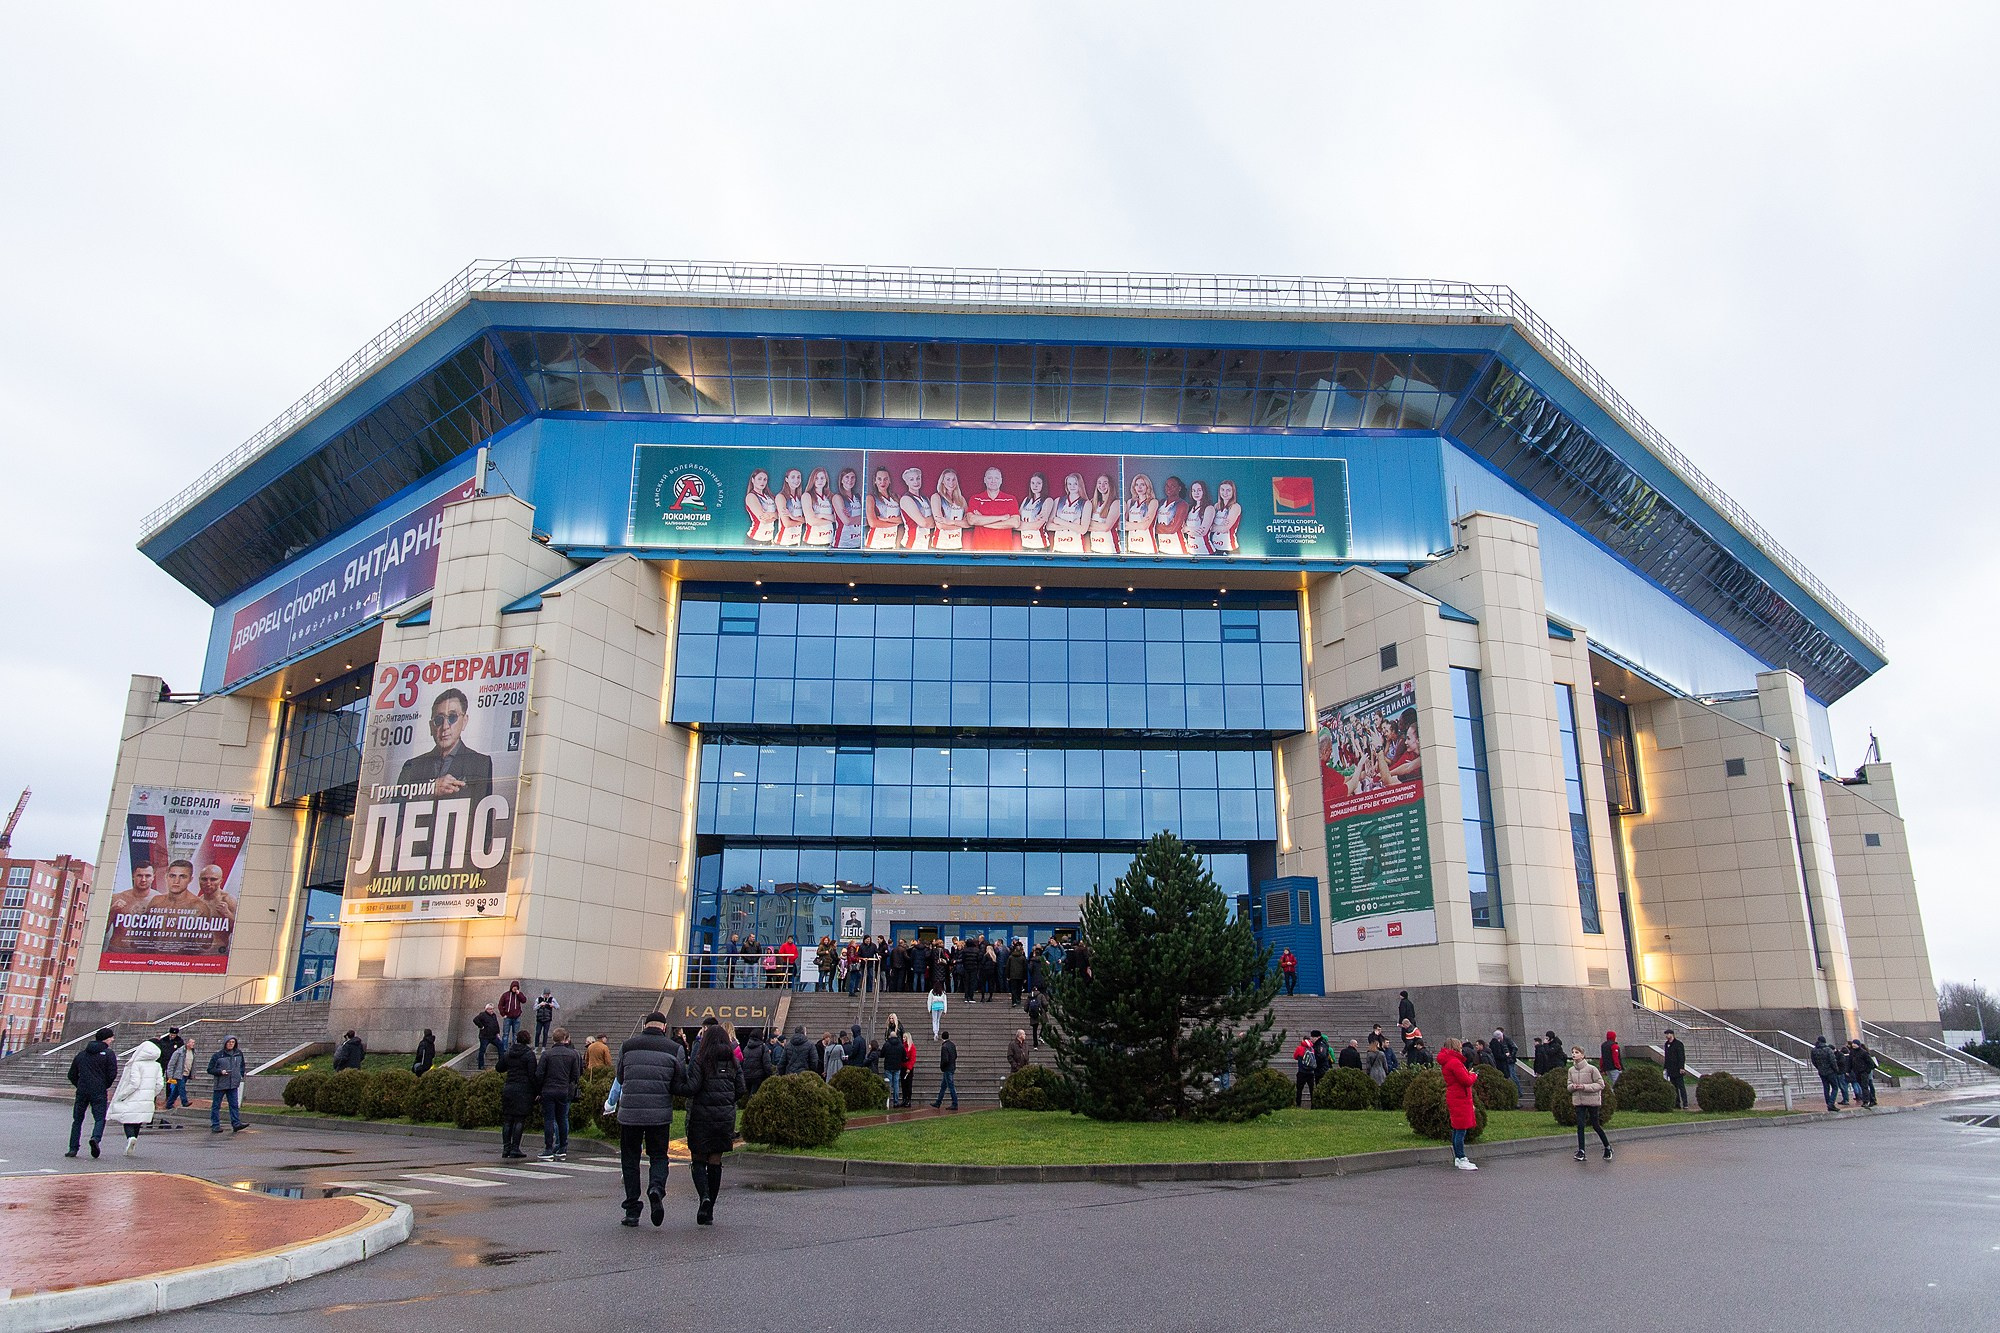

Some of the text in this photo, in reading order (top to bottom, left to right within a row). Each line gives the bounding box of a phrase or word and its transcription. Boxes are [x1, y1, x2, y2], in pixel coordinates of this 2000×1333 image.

[1266, 524, 1325, 533] ЯНТАРНЫЙ
[232, 608, 282, 654] ДВОРЕЦ
[284, 578, 336, 622] СПОРТА
[375, 652, 529, 710] 23 ФЕВРАЛЯ
[479, 681, 526, 694] ИНФОРМАЦИЯ
[477, 692, 525, 708] 507-208
[371, 725, 413, 748] 19:00
[370, 779, 436, 801] Григорий
[163, 795, 168, 805] 1
[171, 795, 220, 809] ФЕВРАЛЯ
[1330, 806, 1357, 818] ДОМАШНИЕ
[1358, 802, 1372, 810] ИГРЫ
[212, 835, 240, 843] ГОРОХОВ
[354, 794, 510, 875] ЛЕПС
[366, 873, 487, 895] «ИДИ И СМОТРИ»
[466, 899, 475, 907] 99
[488, 898, 498, 906] 30
[950, 896, 1023, 907] ВХОД
[115, 913, 164, 929] РОССИЯ
[177, 916, 229, 931] ПОЛЬША
[950, 910, 1023, 921] ENTRY
[841, 927, 864, 936] ЛЕПС
[685, 1006, 767, 1018] КАССЫ
